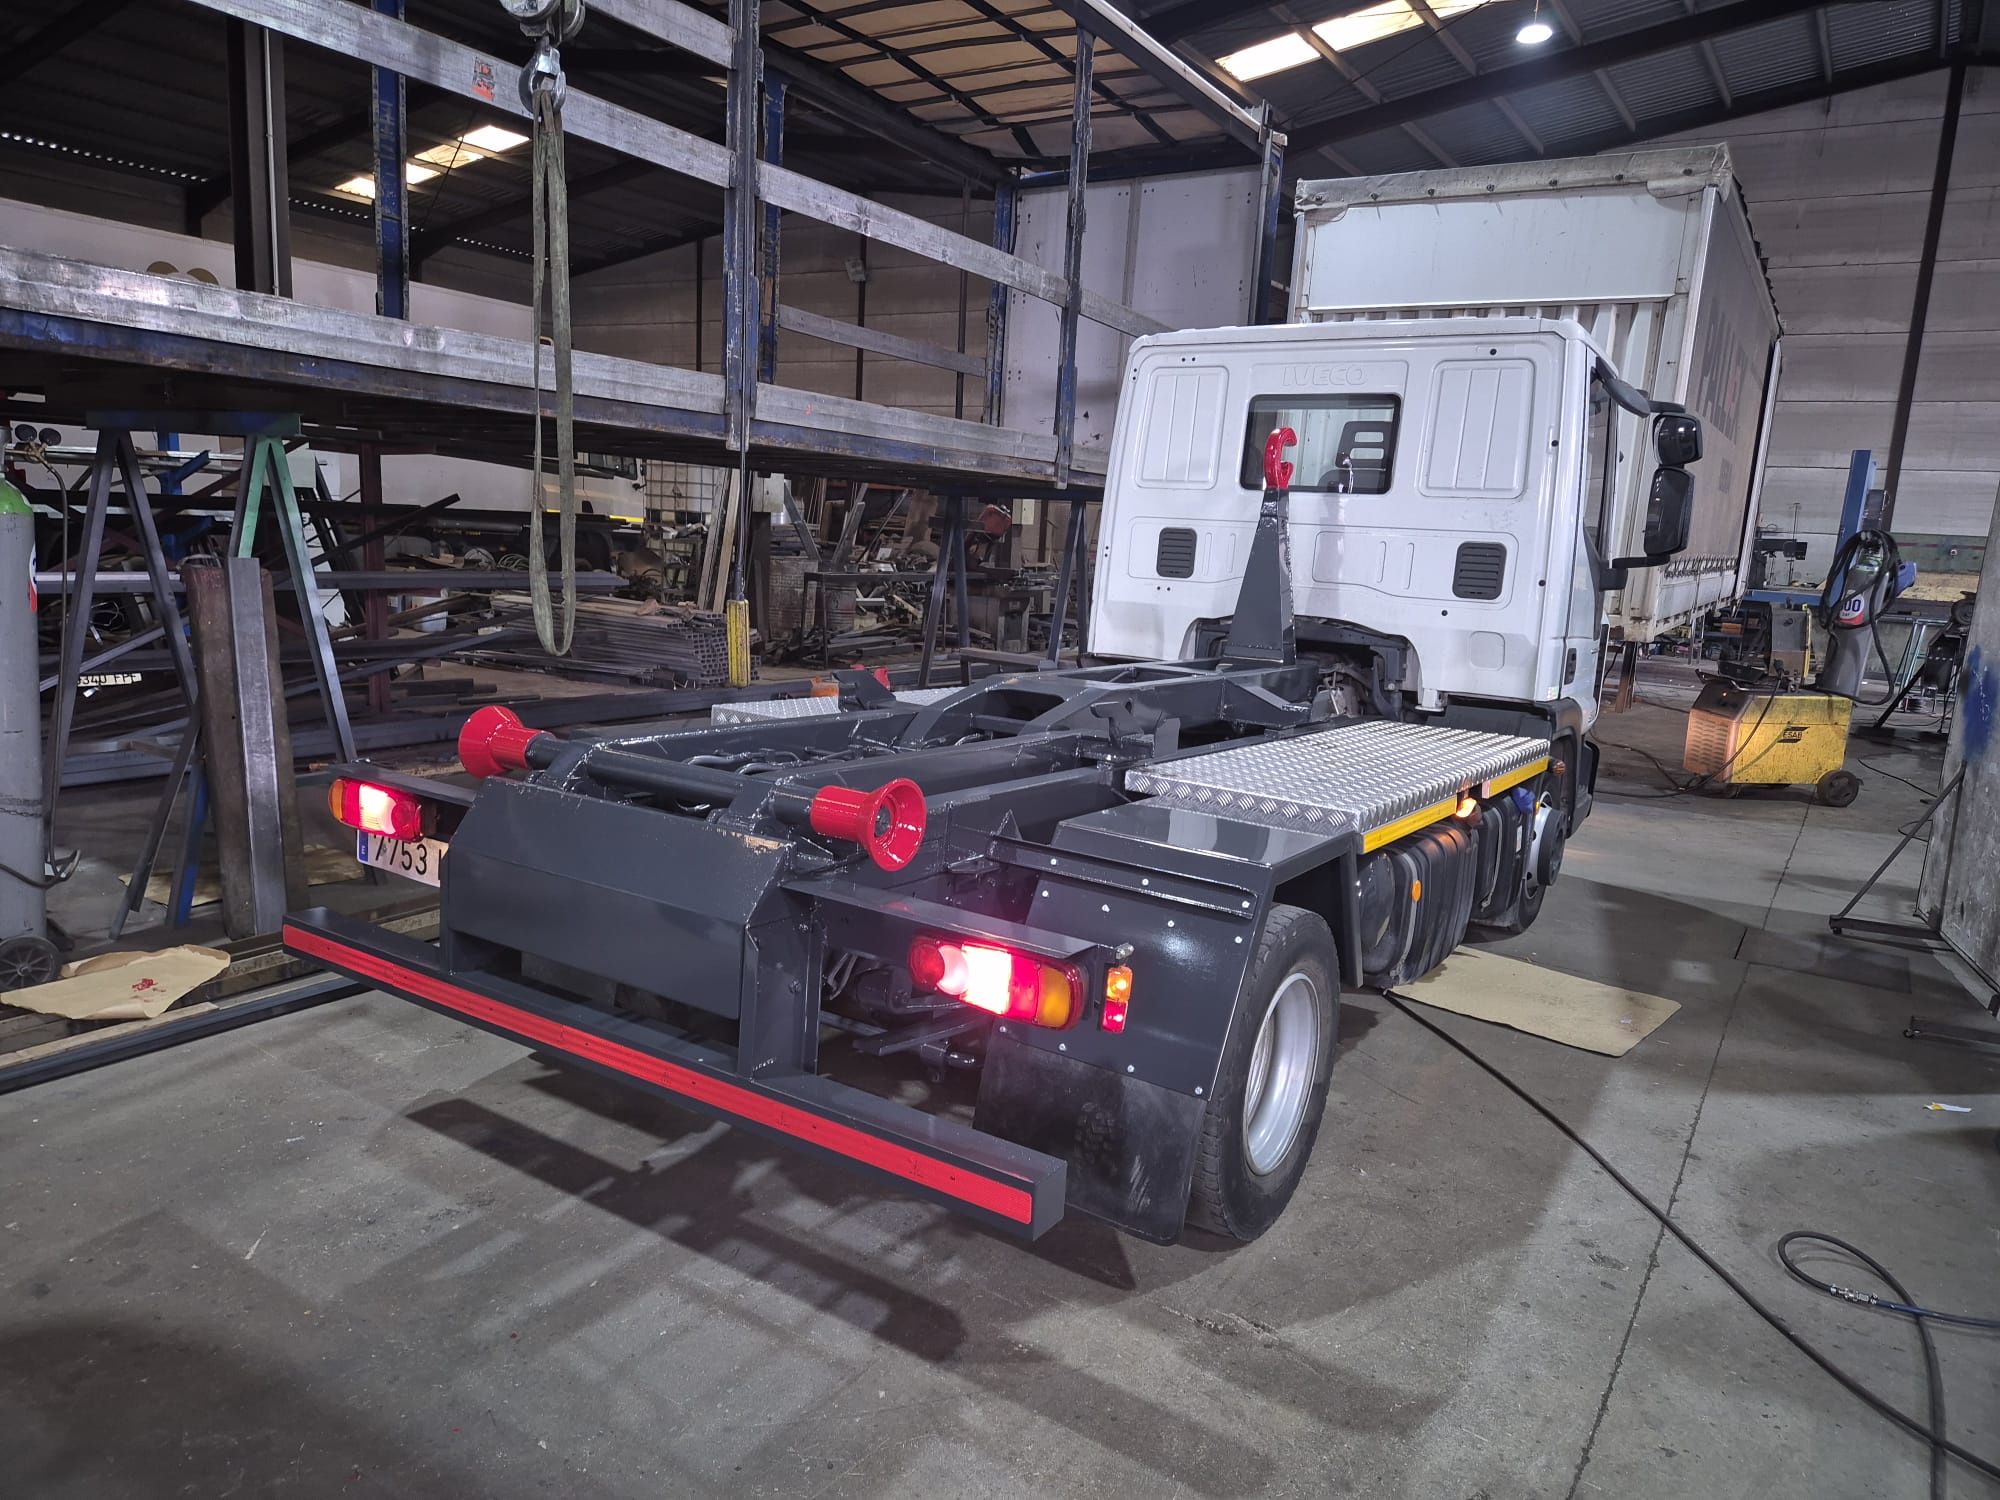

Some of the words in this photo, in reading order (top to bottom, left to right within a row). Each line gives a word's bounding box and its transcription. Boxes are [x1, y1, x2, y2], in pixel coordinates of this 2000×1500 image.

[1282, 365, 1368, 386] IVECO
[1783, 731, 1803, 739] ESAB
[373, 835, 428, 876] 7753
